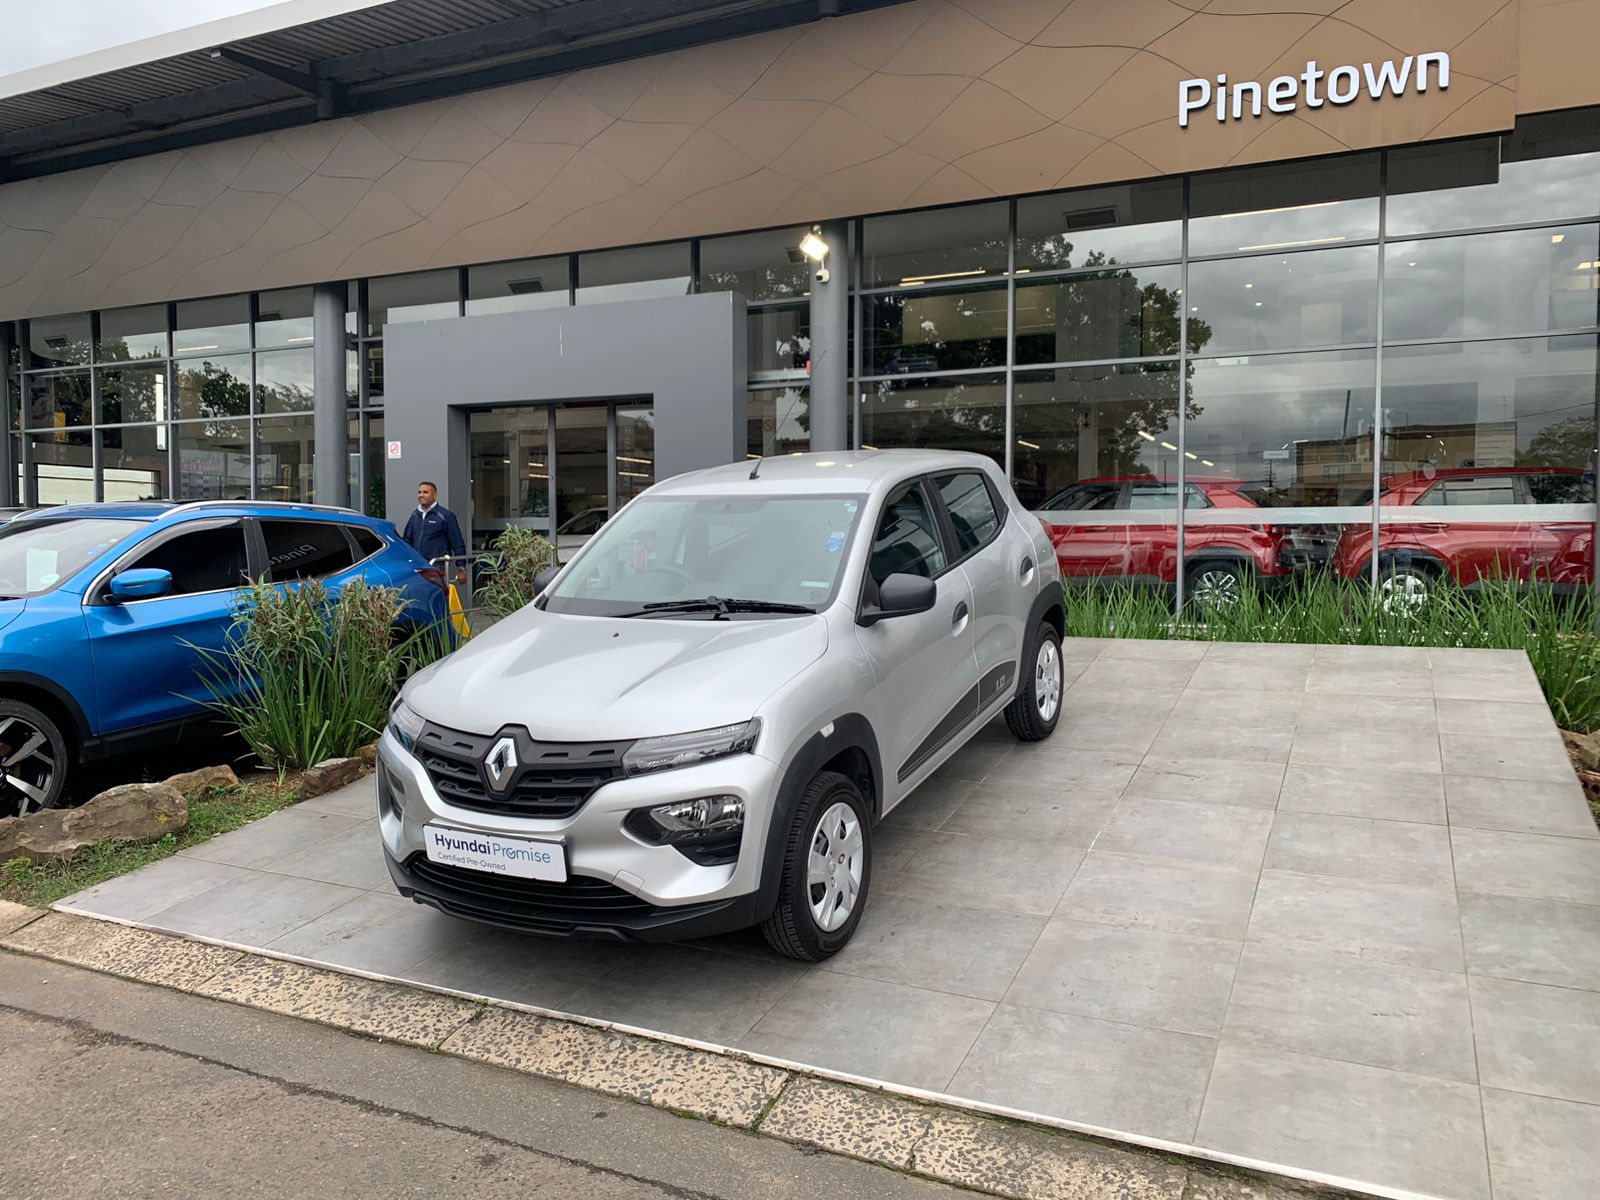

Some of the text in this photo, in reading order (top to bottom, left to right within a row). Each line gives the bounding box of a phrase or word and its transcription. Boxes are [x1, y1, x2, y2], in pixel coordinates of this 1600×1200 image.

[1178, 50, 1450, 127] Pinetown
[434, 832, 551, 864] Hyundai Promise
[437, 851, 507, 871] Certified Pre-Owned
